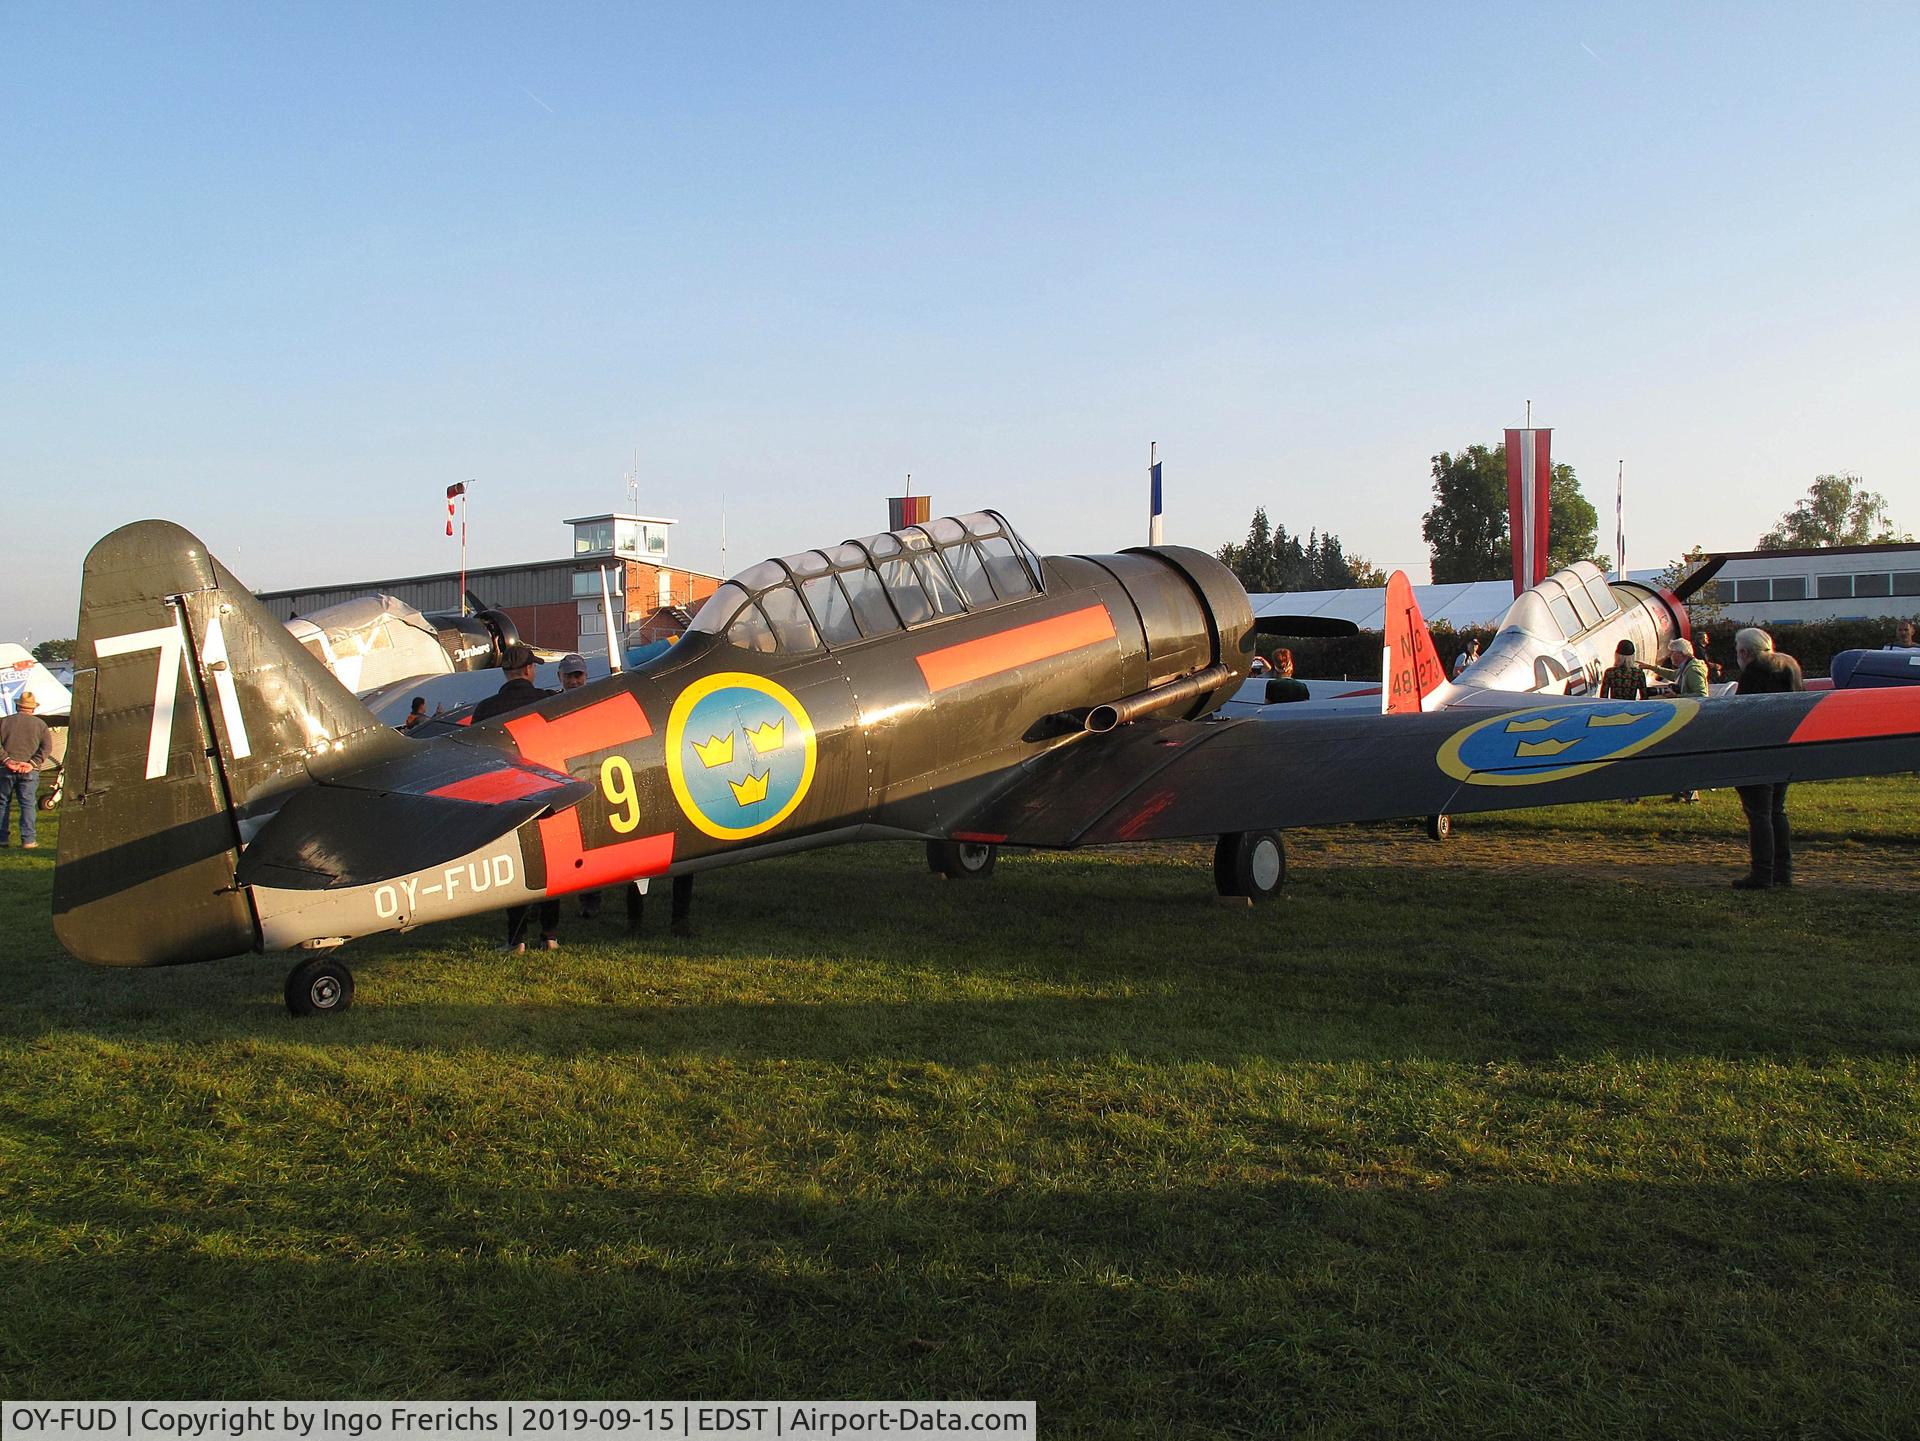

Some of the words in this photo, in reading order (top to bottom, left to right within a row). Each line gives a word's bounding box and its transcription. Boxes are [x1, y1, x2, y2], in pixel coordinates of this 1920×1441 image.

[453, 643, 491, 663] Junkers
[93, 618, 251, 780] 71
[600, 755, 641, 834] 9
[373, 853, 515, 919] OY-FUD
